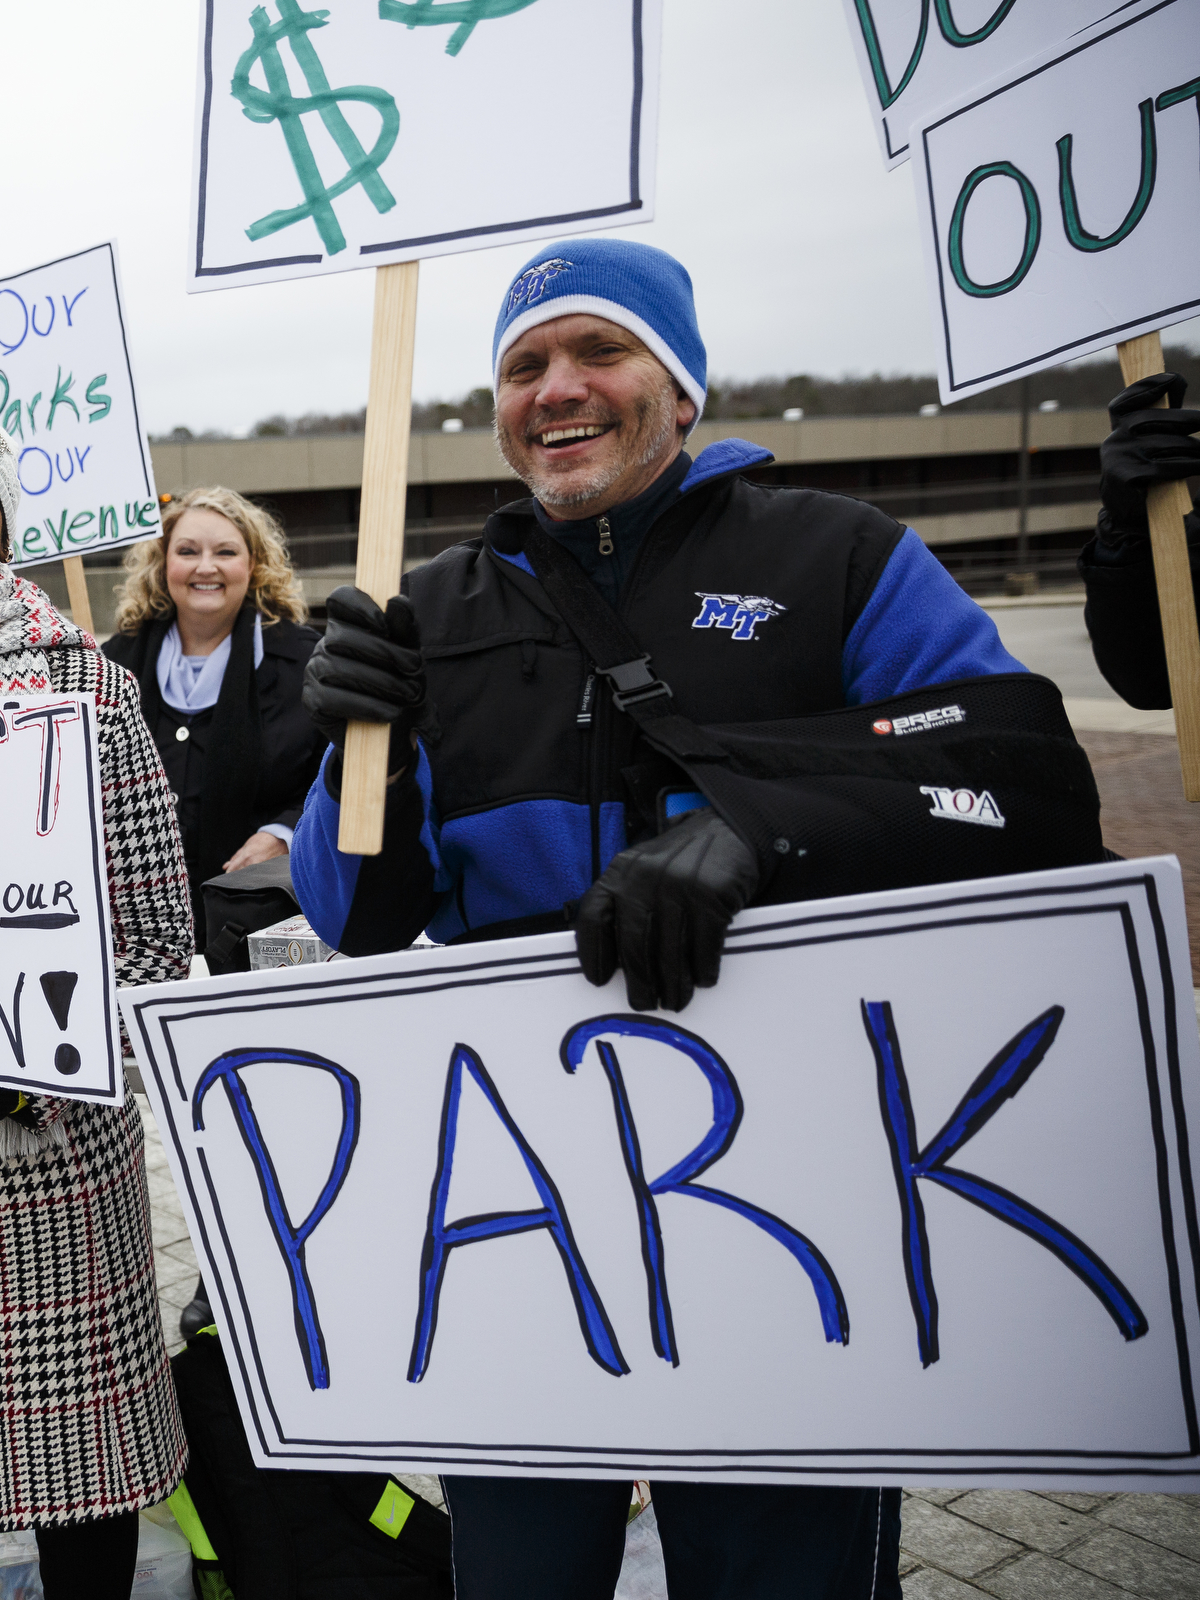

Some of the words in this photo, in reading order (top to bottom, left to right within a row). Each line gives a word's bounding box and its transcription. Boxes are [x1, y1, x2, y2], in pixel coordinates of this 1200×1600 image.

[17, 445, 93, 496] Our
[12, 500, 159, 566] evenue
[691, 597, 771, 641] MT
[584, 675, 596, 695] Charles
[582, 695, 590, 711] River
[892, 705, 961, 730] BREG
[922, 787, 1001, 819] TOA
[2, 880, 78, 914] OUR
[192, 998, 1150, 1391] PARK
